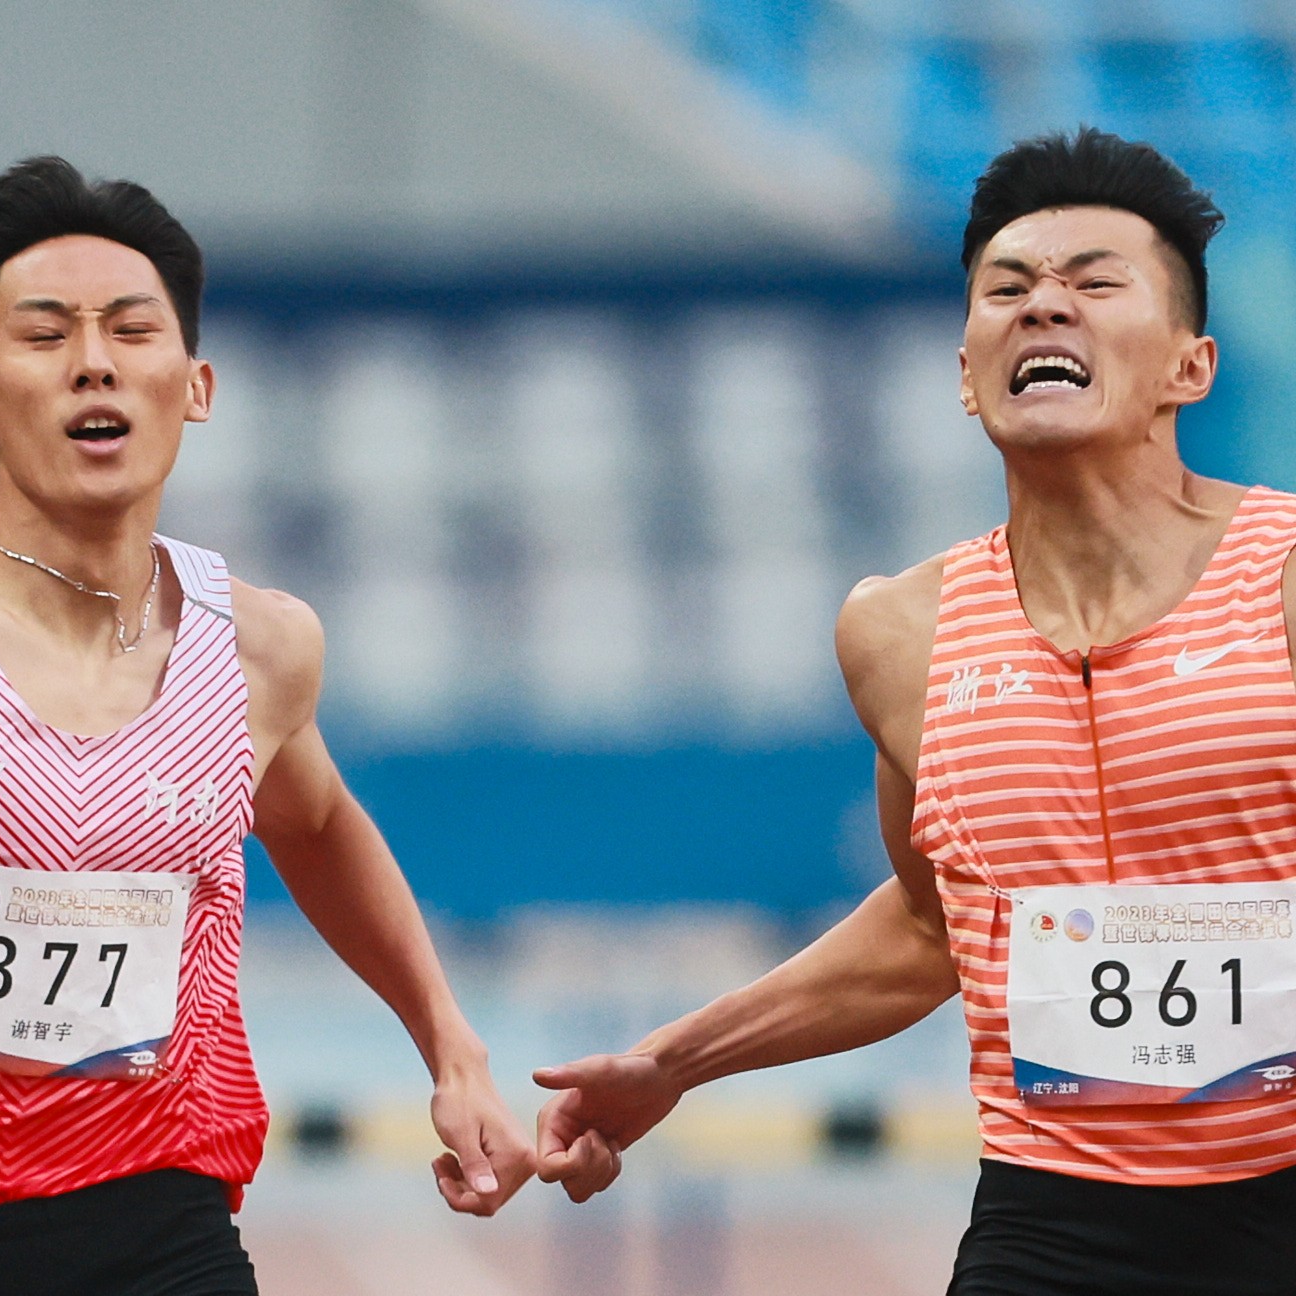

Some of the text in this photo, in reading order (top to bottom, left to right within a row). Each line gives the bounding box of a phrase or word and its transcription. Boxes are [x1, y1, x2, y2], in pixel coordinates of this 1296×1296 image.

[947, 663, 1034, 714] 浙江
[144, 770, 220, 826] 河南
[1090, 958, 1242, 1029] 861
[10, 1019, 73, 1042] 谢智宇
[1132, 1043, 1197, 1065] 冯志强
